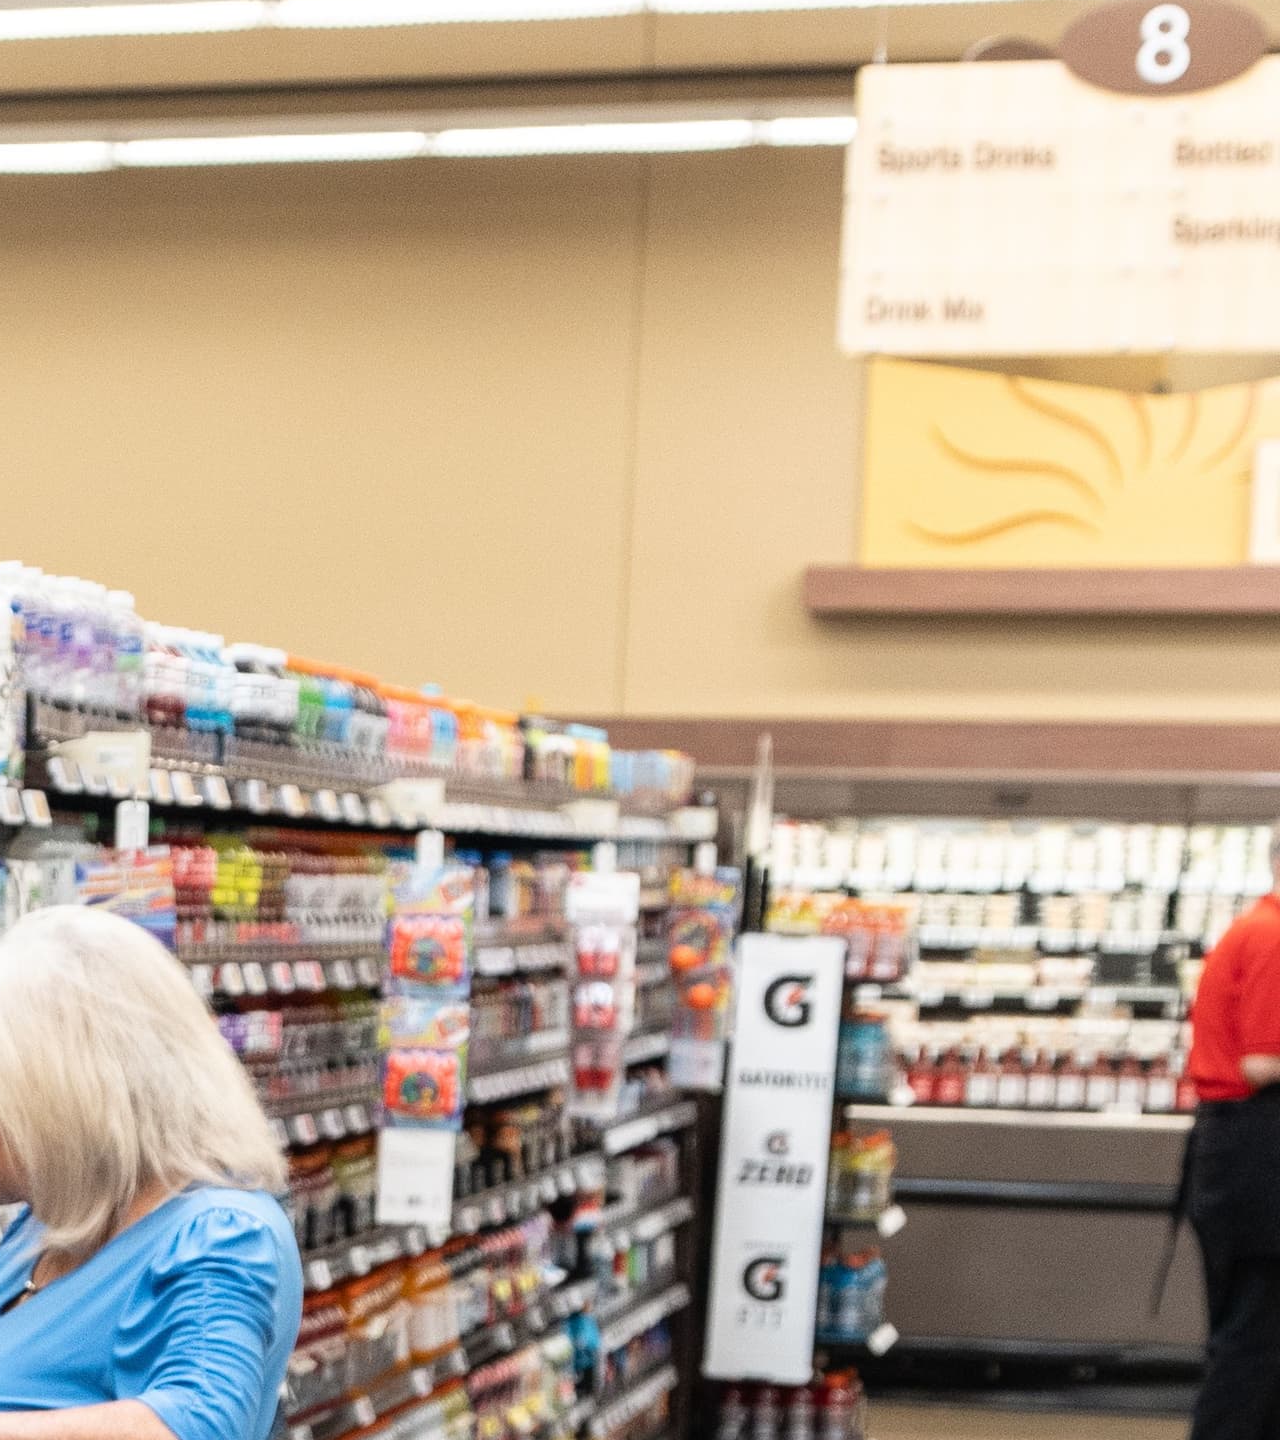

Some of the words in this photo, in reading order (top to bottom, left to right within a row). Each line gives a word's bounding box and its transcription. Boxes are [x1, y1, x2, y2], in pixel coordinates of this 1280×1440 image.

[1135, 3, 1191, 85] 8
[762, 973, 814, 1028] G
[742, 1257, 790, 1303] G
